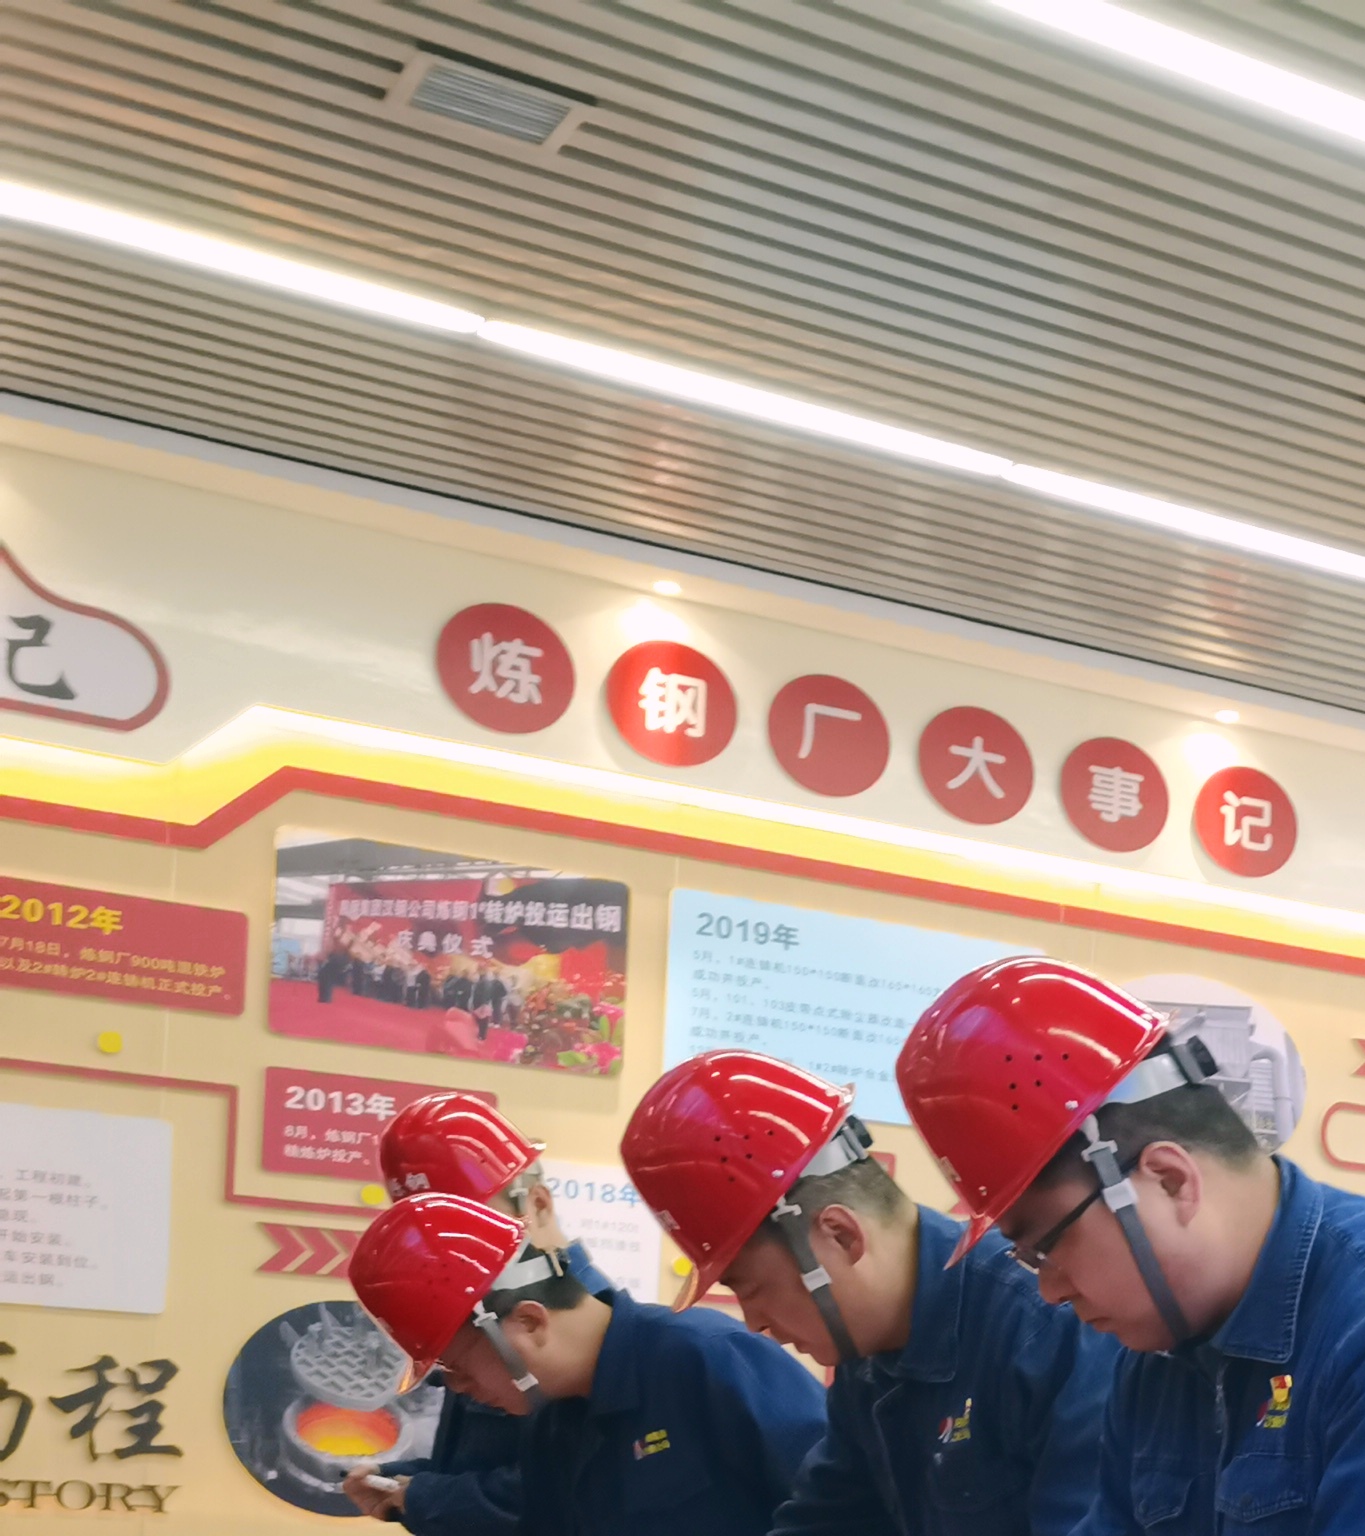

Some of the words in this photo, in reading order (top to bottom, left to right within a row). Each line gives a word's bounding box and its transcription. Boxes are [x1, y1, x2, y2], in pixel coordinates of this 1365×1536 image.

[467, 630, 1274, 853] 炼钢厂大事记
[0, 894, 124, 936] 2012年
[695, 911, 801, 951] 2019年
[284, 1085, 398, 1122] 2013年
[546, 1177, 642, 1208] 2018年
